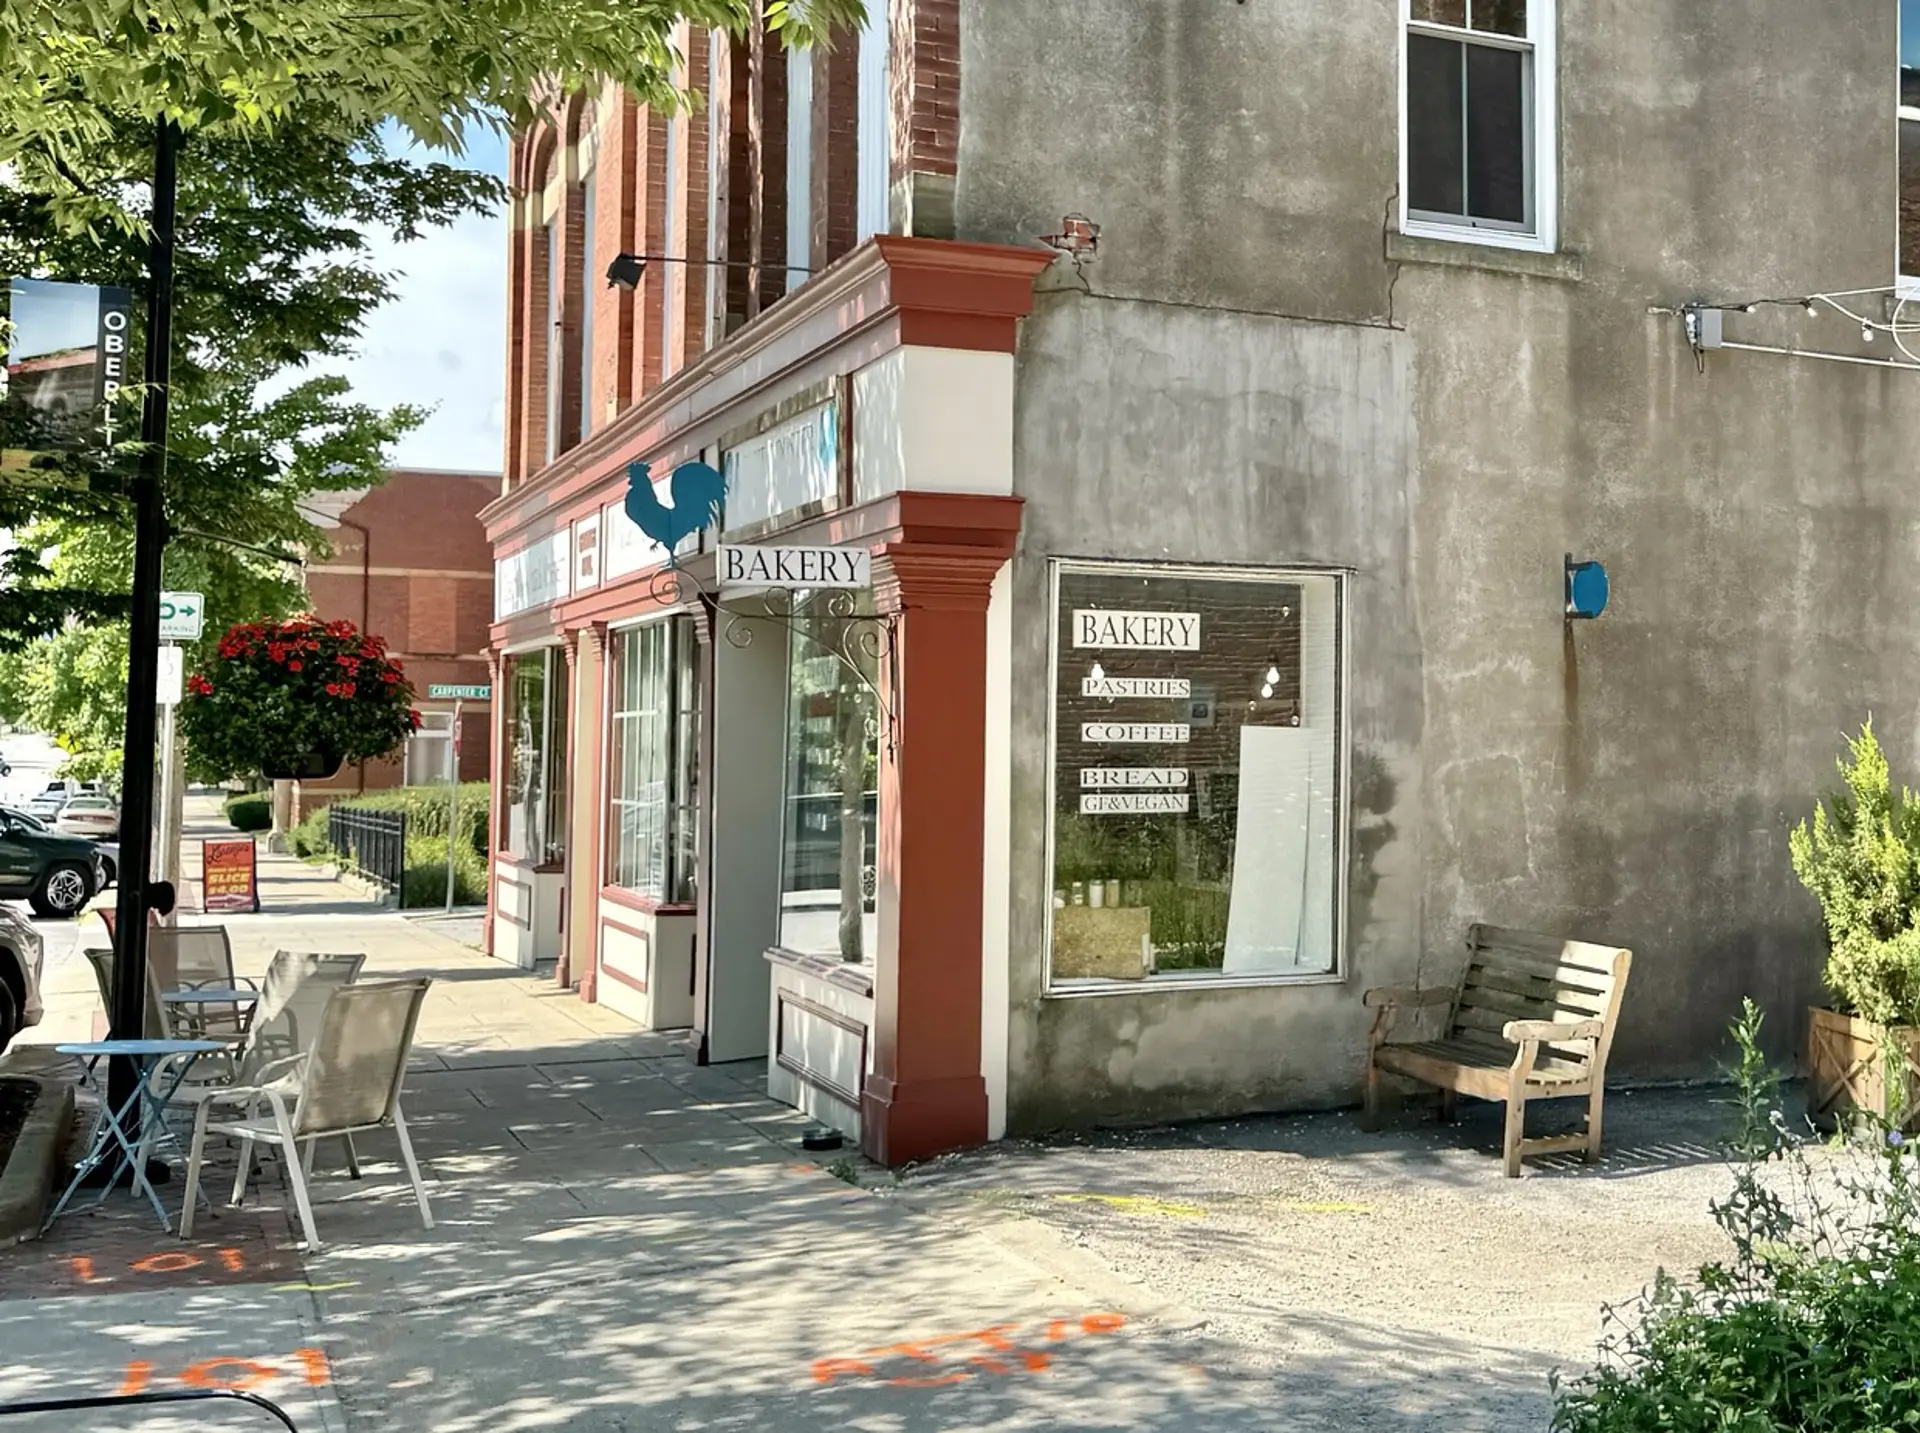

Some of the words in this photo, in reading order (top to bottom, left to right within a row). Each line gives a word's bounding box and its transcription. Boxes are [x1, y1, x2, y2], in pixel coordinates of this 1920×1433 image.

[726, 548, 867, 582] BAKERY
[1081, 614, 1196, 646] BAKERY
[1086, 679, 1189, 696] PASTRIES
[1085, 724, 1189, 741] COFFEE
[1083, 770, 1187, 785] BREAD
[208, 872, 249, 884] SLICE
